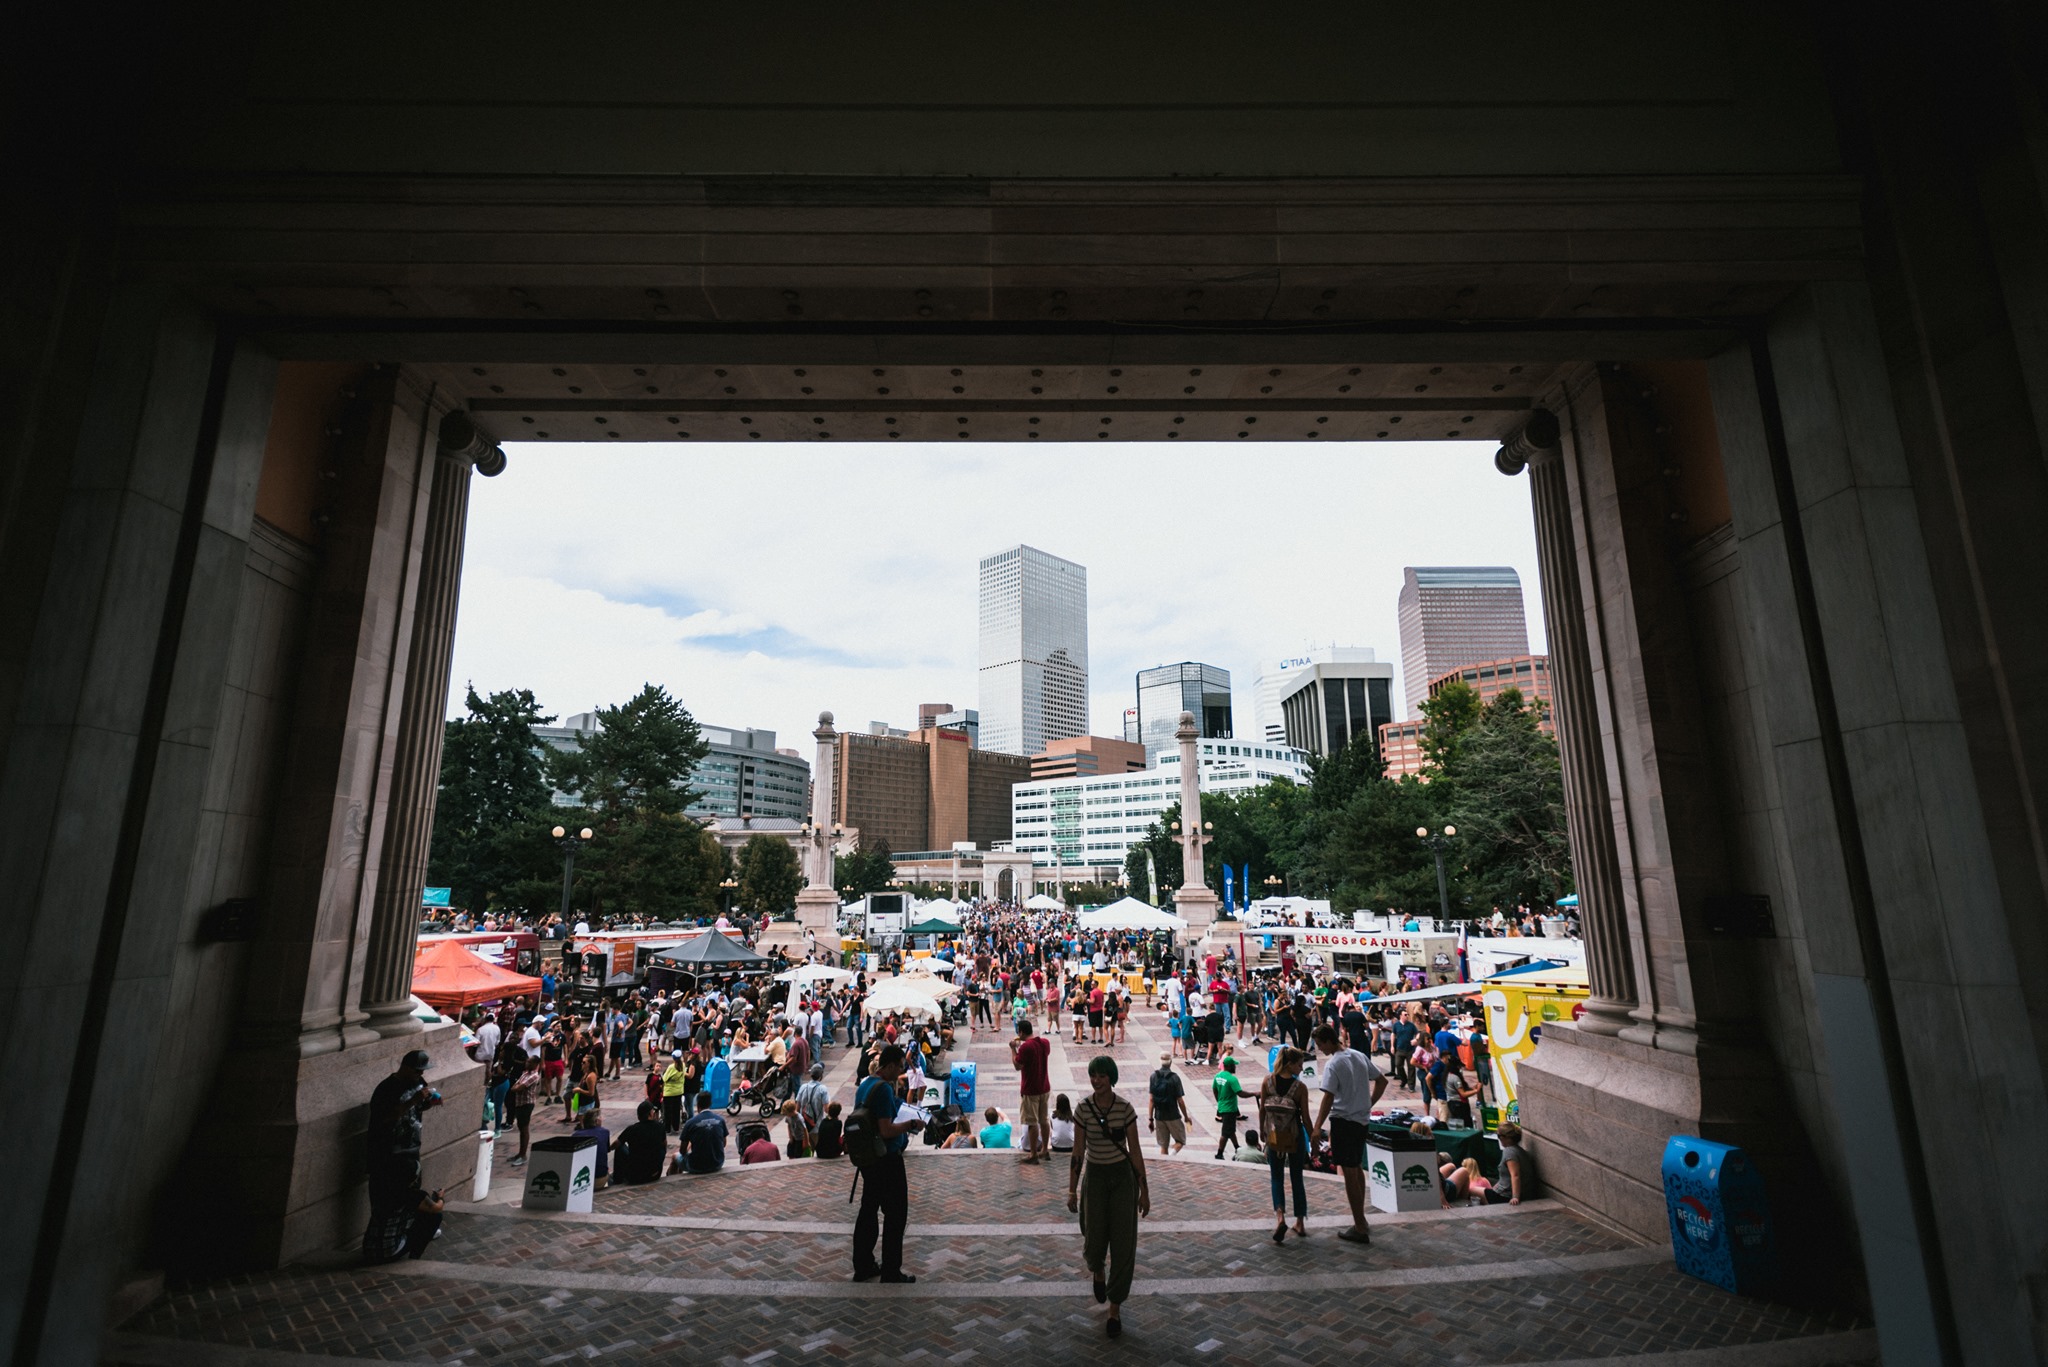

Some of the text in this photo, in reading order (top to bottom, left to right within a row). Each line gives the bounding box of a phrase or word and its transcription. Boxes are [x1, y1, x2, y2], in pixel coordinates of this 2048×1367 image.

[1290, 657, 1311, 668] TIAA
[1305, 935, 1349, 945] KINGS
[1360, 937, 1411, 948] CAJUN
[1677, 1208, 1714, 1231] RECYCLE
[1686, 1223, 1709, 1241] HERE
[1734, 1223, 1767, 1235] RECYCLE
